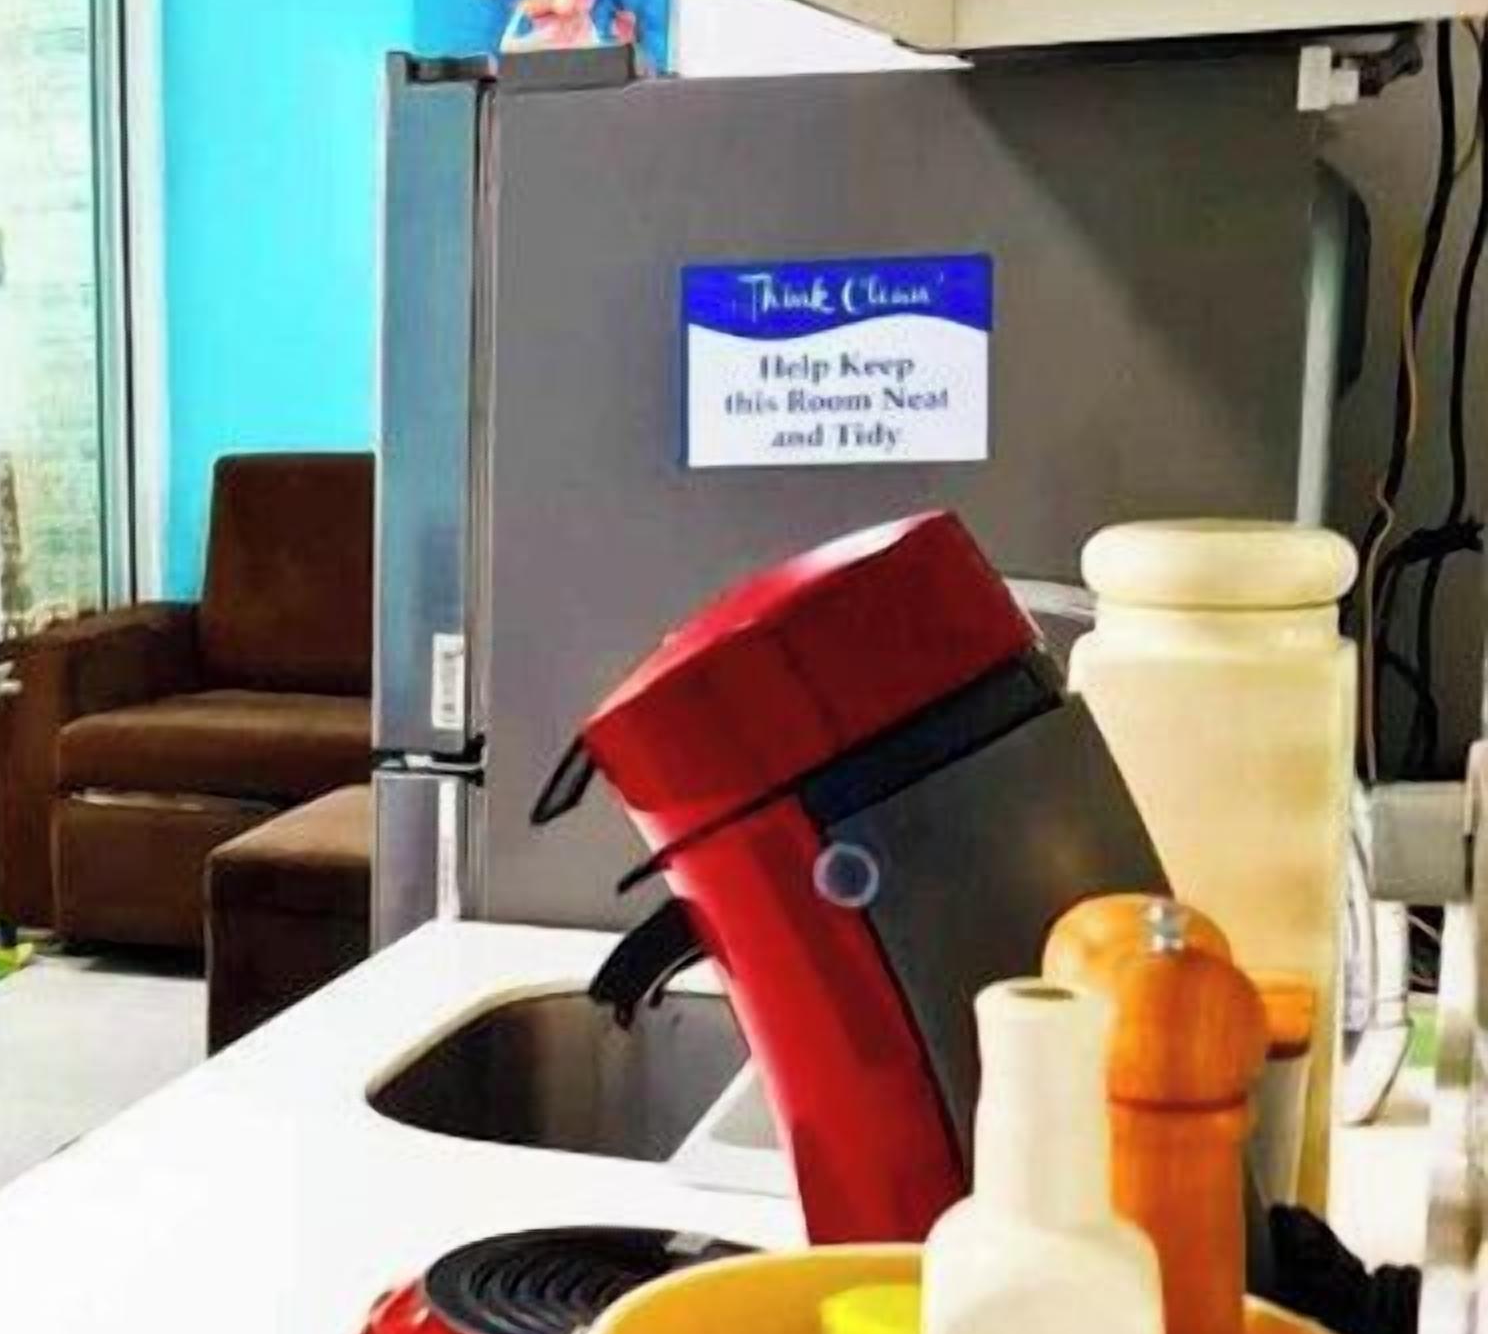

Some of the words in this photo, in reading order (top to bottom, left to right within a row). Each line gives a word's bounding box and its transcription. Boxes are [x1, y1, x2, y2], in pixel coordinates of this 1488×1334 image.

[760, 352, 830, 385] Help
[840, 352, 916, 379] Keep
[725, 390, 779, 415] this
[787, 389, 872, 414] Room
[771, 422, 824, 448] and
[836, 421, 900, 452] Tidy
